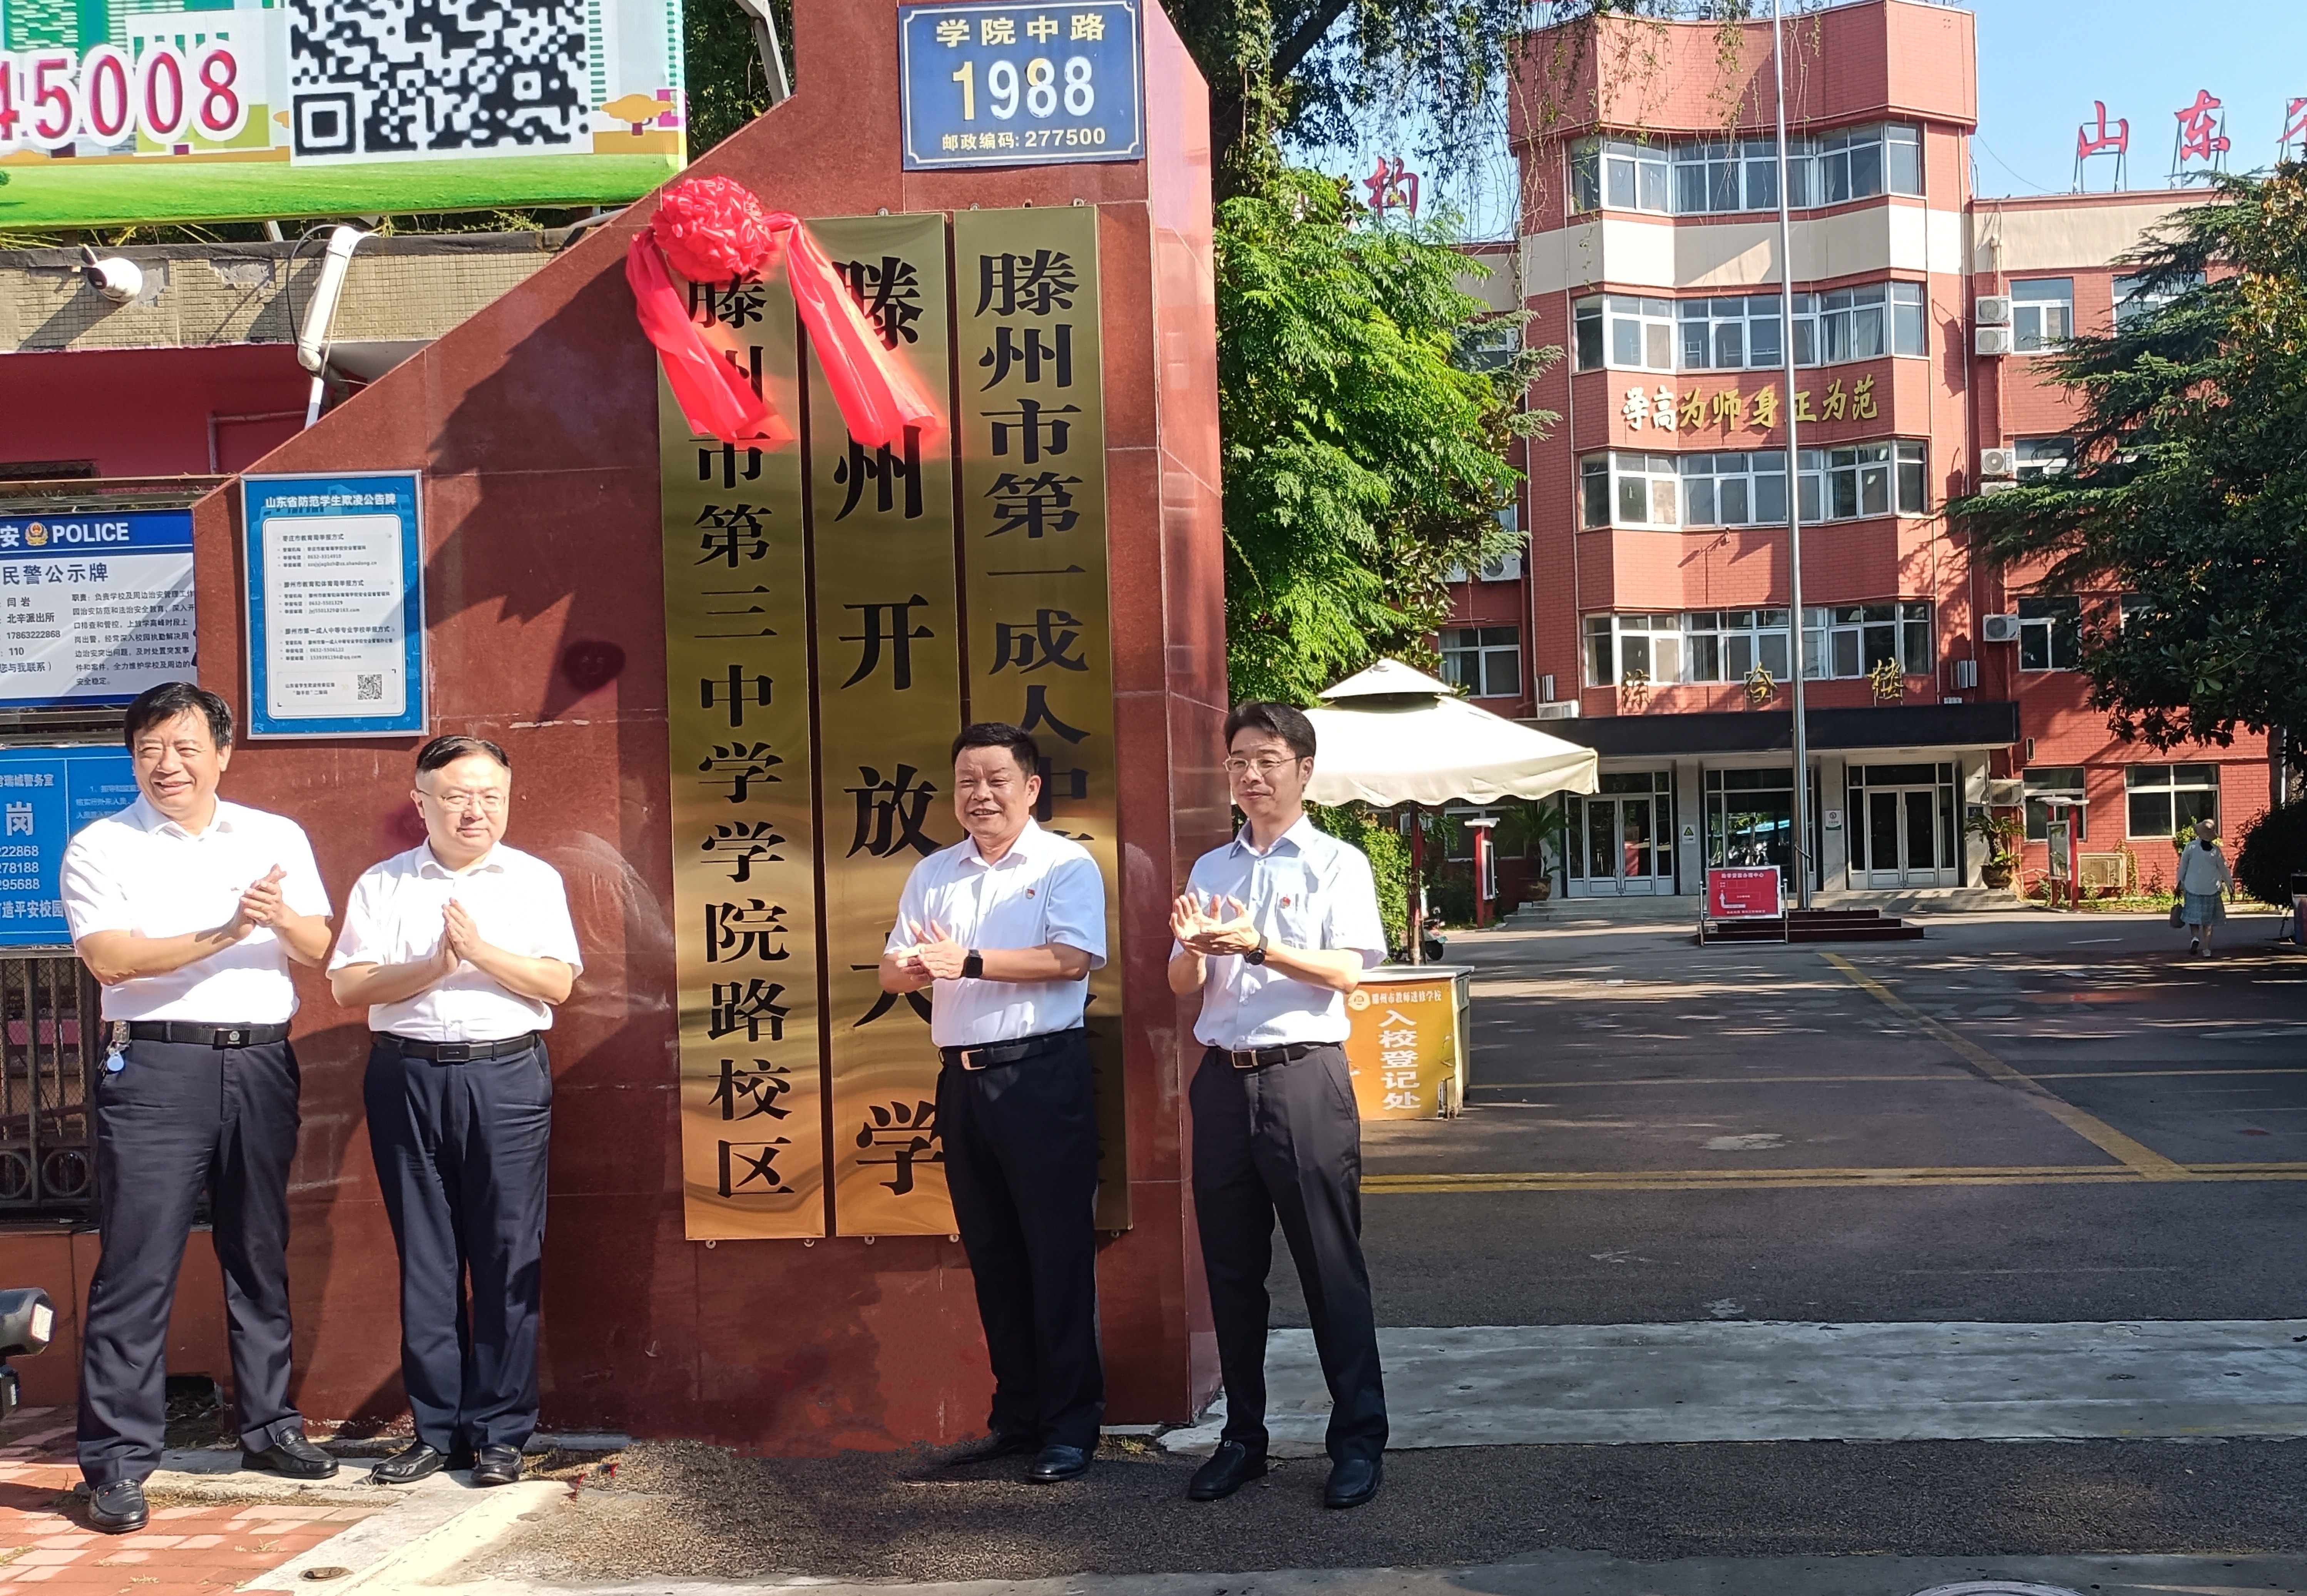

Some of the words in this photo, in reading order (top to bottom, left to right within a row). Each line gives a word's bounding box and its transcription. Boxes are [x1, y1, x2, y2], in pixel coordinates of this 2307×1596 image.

[936, 13, 1105, 48] 学院中路
[952, 56, 1094, 120] 1988
[266, 493, 396, 509] 山东省防范学生欺凌公告牌
[0, 525, 20, 547] 安
[52, 523, 129, 543] POLICE
[3, 563, 108, 585] 民警公示牌
[7, 612, 55, 624] 北辛派出所
[7, 630, 61, 639] 17863222868
[9, 647, 24, 656] 110
[6, 801, 33, 836] 岗
[0, 845, 39, 857] 22868
[0, 862, 39, 873] 78188
[0, 878, 40, 890] 95688
[0, 900, 64, 919] 造平安校园
[1378, 1009, 1421, 1111] 入校登记处
